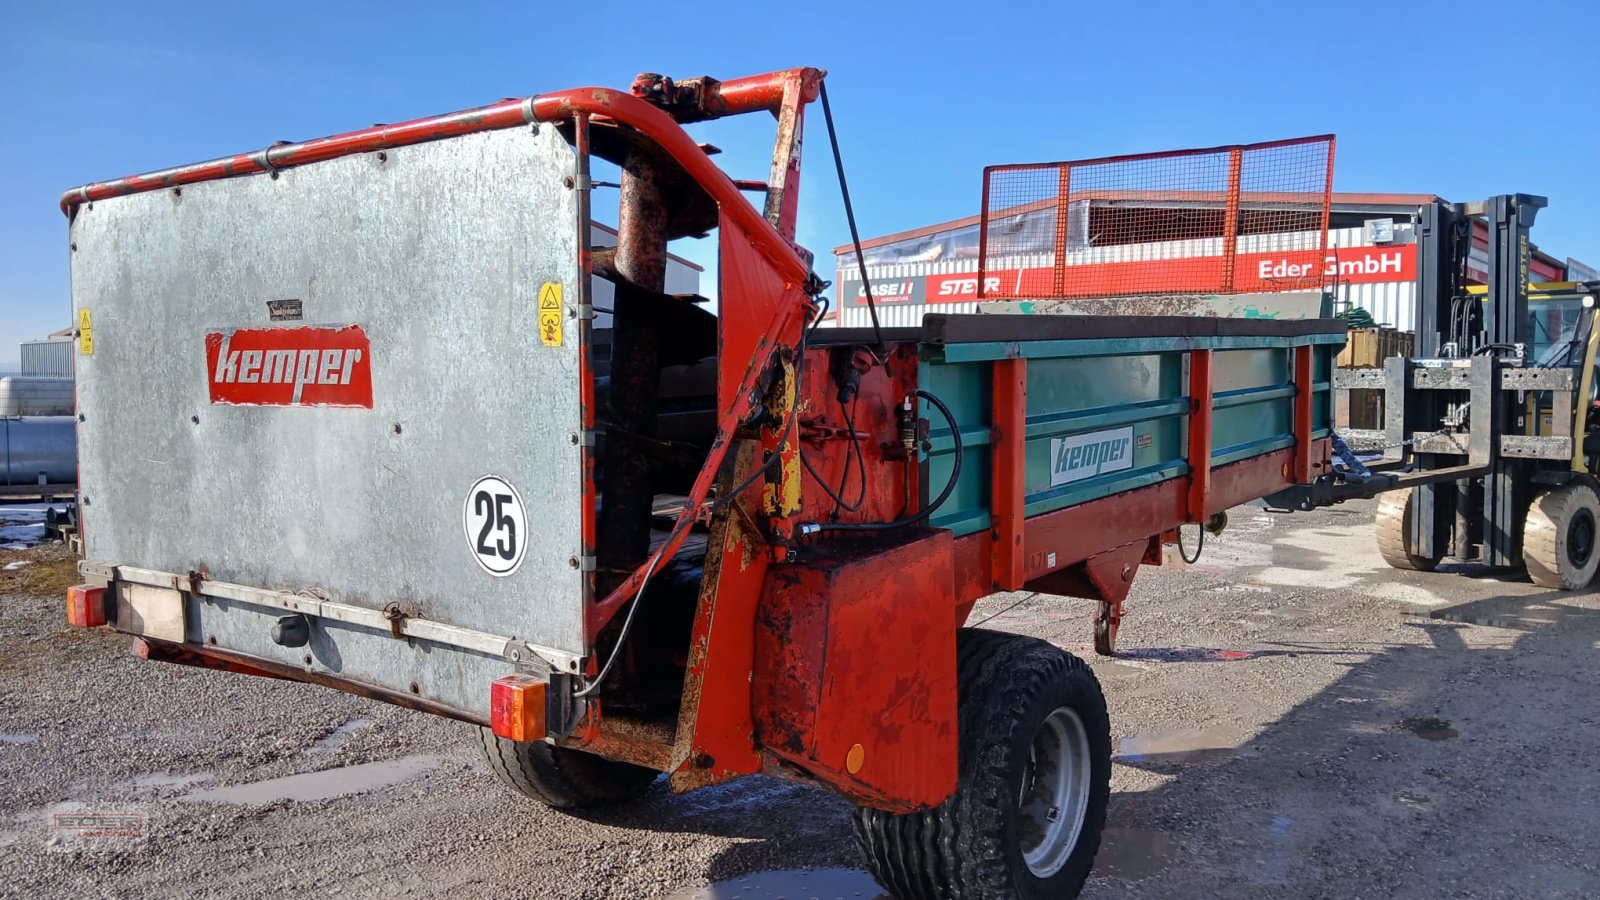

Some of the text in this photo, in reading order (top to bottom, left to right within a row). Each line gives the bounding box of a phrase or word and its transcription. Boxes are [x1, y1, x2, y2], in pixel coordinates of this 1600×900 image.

[1258, 252, 1402, 279] Eder GmbH
[858, 283, 899, 297] CASE
[214, 337, 362, 403] kemper
[1054, 437, 1129, 474] kemper
[475, 490, 516, 561] 25
